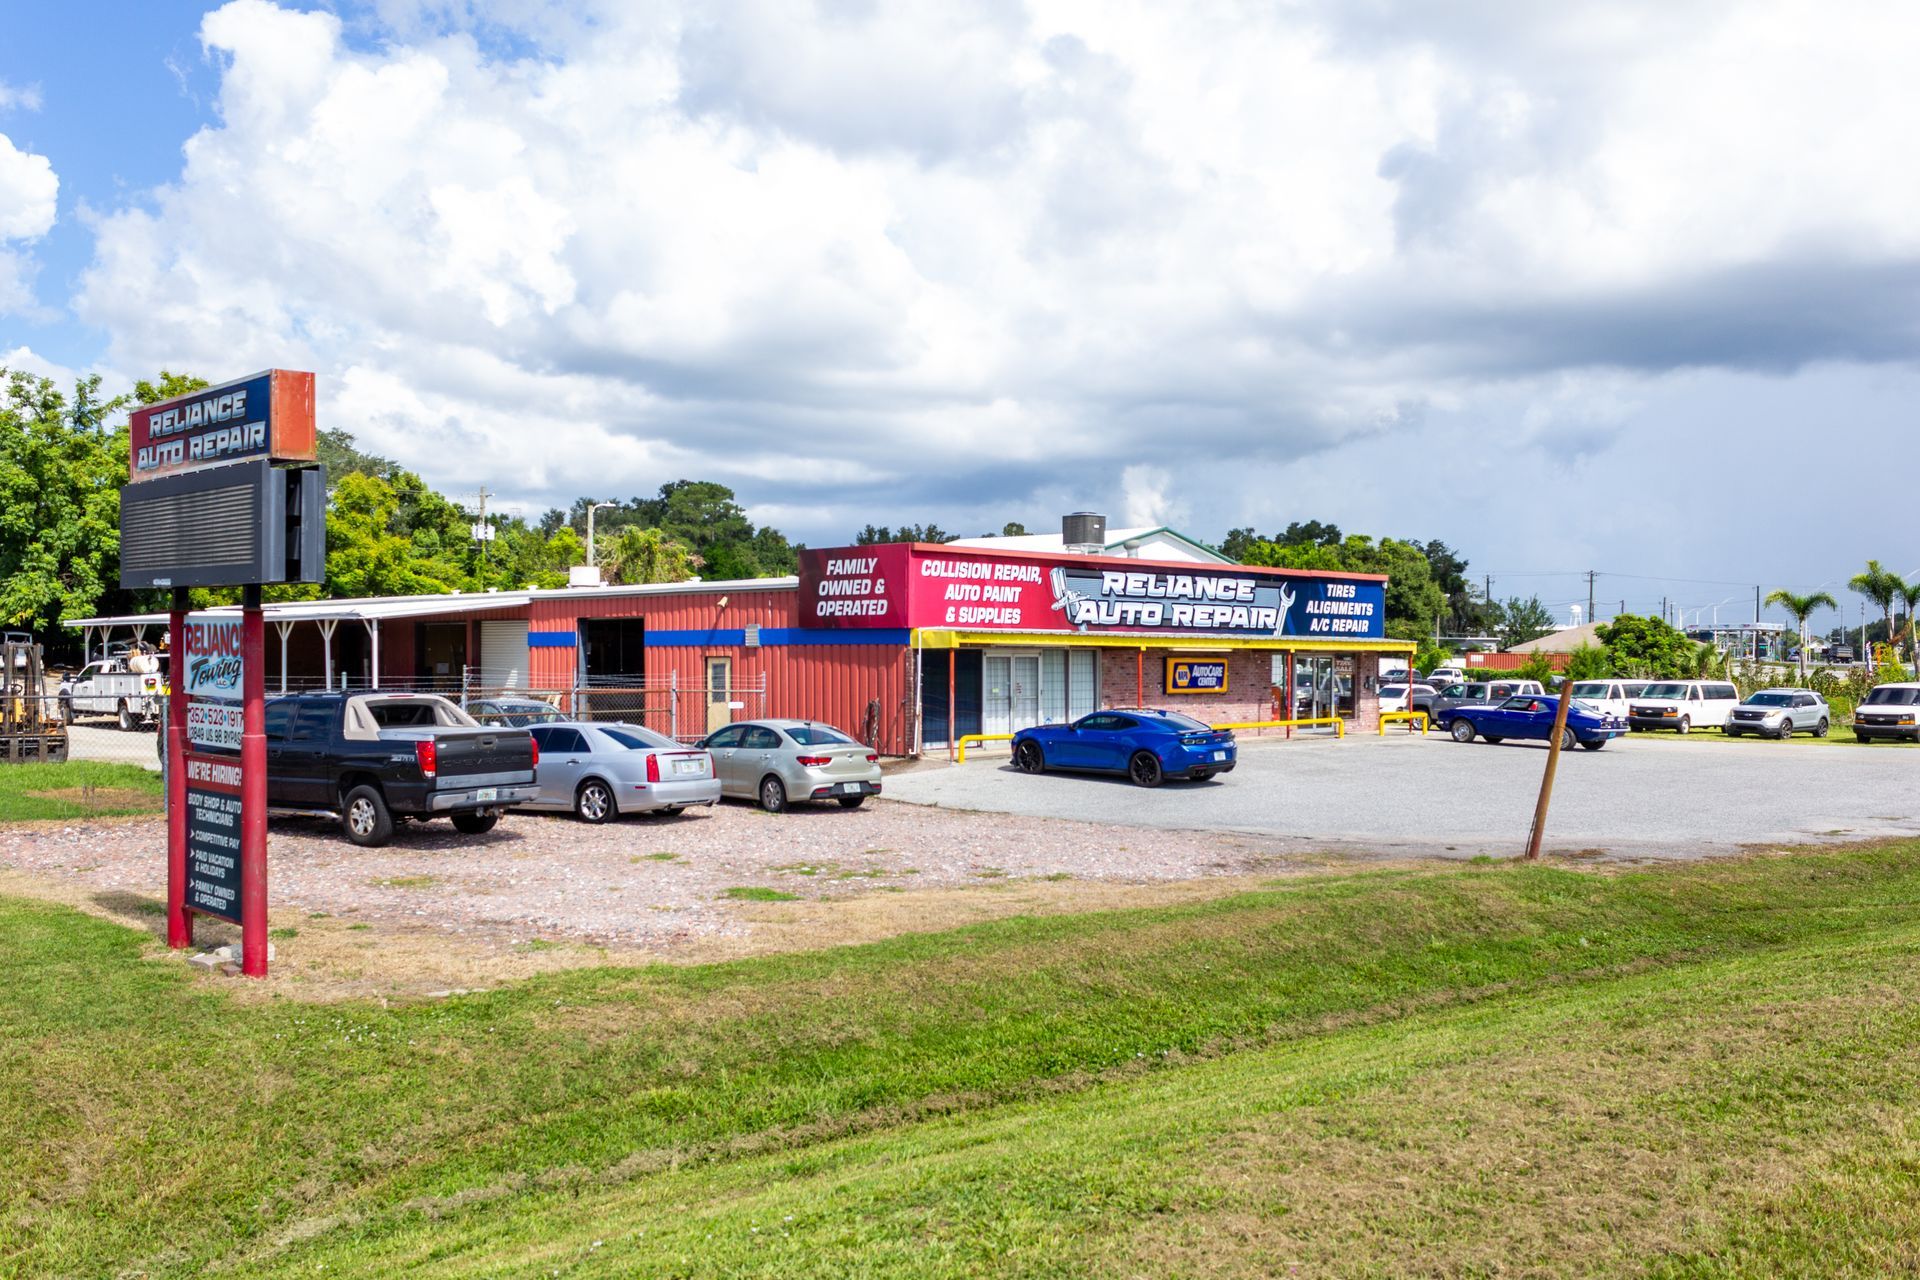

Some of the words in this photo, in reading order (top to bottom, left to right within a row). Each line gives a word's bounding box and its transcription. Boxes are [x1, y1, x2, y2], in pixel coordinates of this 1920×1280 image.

[149, 390, 247, 439] RELIANCE
[137, 440, 184, 471] AUTO
[189, 422, 266, 460] REPAIR
[826, 557, 878, 576] FAMILY
[921, 559, 992, 580] COLLISION
[994, 564, 1043, 585] REPAIR,
[818, 578, 871, 597] OWNED
[874, 578, 885, 595] &
[944, 583, 981, 602] AUTO
[982, 585, 1022, 603] PAINT
[1101, 570, 1257, 602] RELIANCE
[1326, 583, 1356, 599] TIRES
[816, 599, 888, 617] OPERATED
[945, 606, 956, 623] &
[958, 607, 1021, 625] SUPPLIES
[1074, 600, 1165, 627] AUTO
[1171, 603, 1278, 631] REPAIR
[1306, 596, 1374, 617] ALIGNMENTS
[1310, 617, 1330, 632] A/C
[1331, 618, 1369, 633] REPAIR
[190, 658, 242, 690] Towing
[1197, 677, 1217, 686] CENTER
[206, 728, 213, 742] US
[214, 729, 222, 743] 98
[187, 760, 211, 782] WE'RE
[211, 763, 242, 787] HIRING!
[188, 792, 203, 806] BODY
[204, 796, 219, 810] SHOP
[220, 799, 225, 810] &
[225, 800, 242, 815] AUTO
[195, 808, 234, 827] TECHNICIANS
[195, 829, 228, 846] COMPETITIVE
[229, 837, 240, 850] PAY
[195, 849, 208, 863] PAID
[208, 852, 234, 869] VACATION
[195, 863, 200, 872] &
[200, 864, 225, 879] HOLIDAYS
[195, 879, 213, 895] FAMILY
[214, 884, 235, 901] OWNED
[195, 893, 200, 902] &
[200, 893, 226, 911] OPERATED
